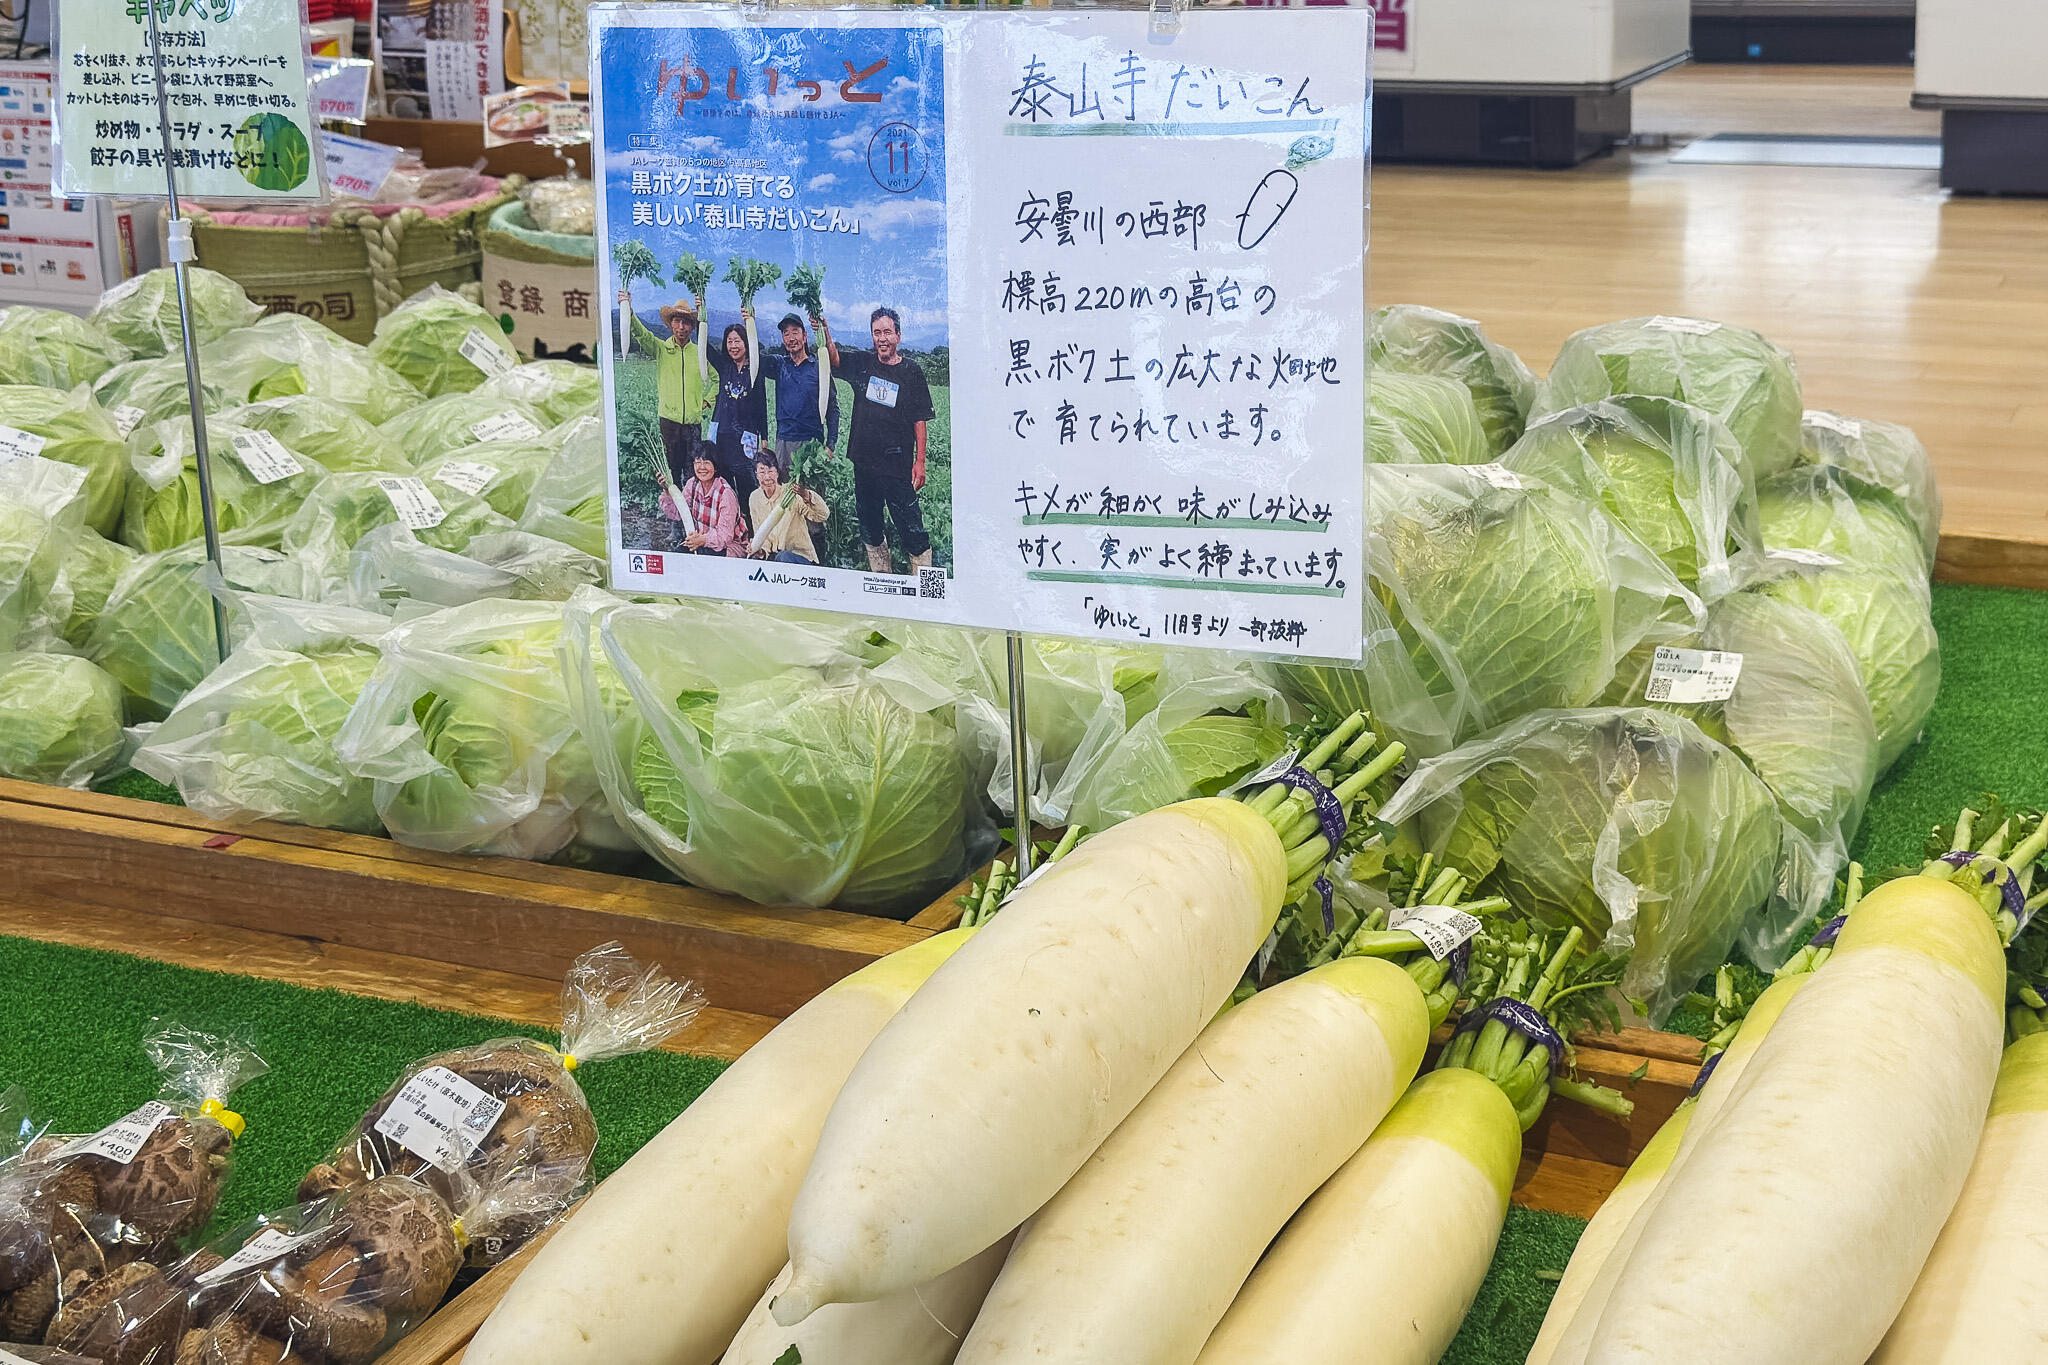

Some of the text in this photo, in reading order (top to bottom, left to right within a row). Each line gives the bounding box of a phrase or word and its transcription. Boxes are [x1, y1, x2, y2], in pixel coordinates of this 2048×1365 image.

[66, 92, 297, 107] カットしたものはラッで包み、早めに使い切る。
[657, 55, 889, 116] ゆいっと
[887, 128, 907, 138] 2021
[885, 141, 908, 174] 11
[631, 170, 795, 198] 黒ボク土が育てる
[632, 201, 860, 234] 美しい「泰山寺だいこん」
[1015, 190, 1206, 251] 安曇川の西部
[1002, 270, 1276, 316] 標高220mの高台の
[1012, 399, 1282, 447] で育てられています。
